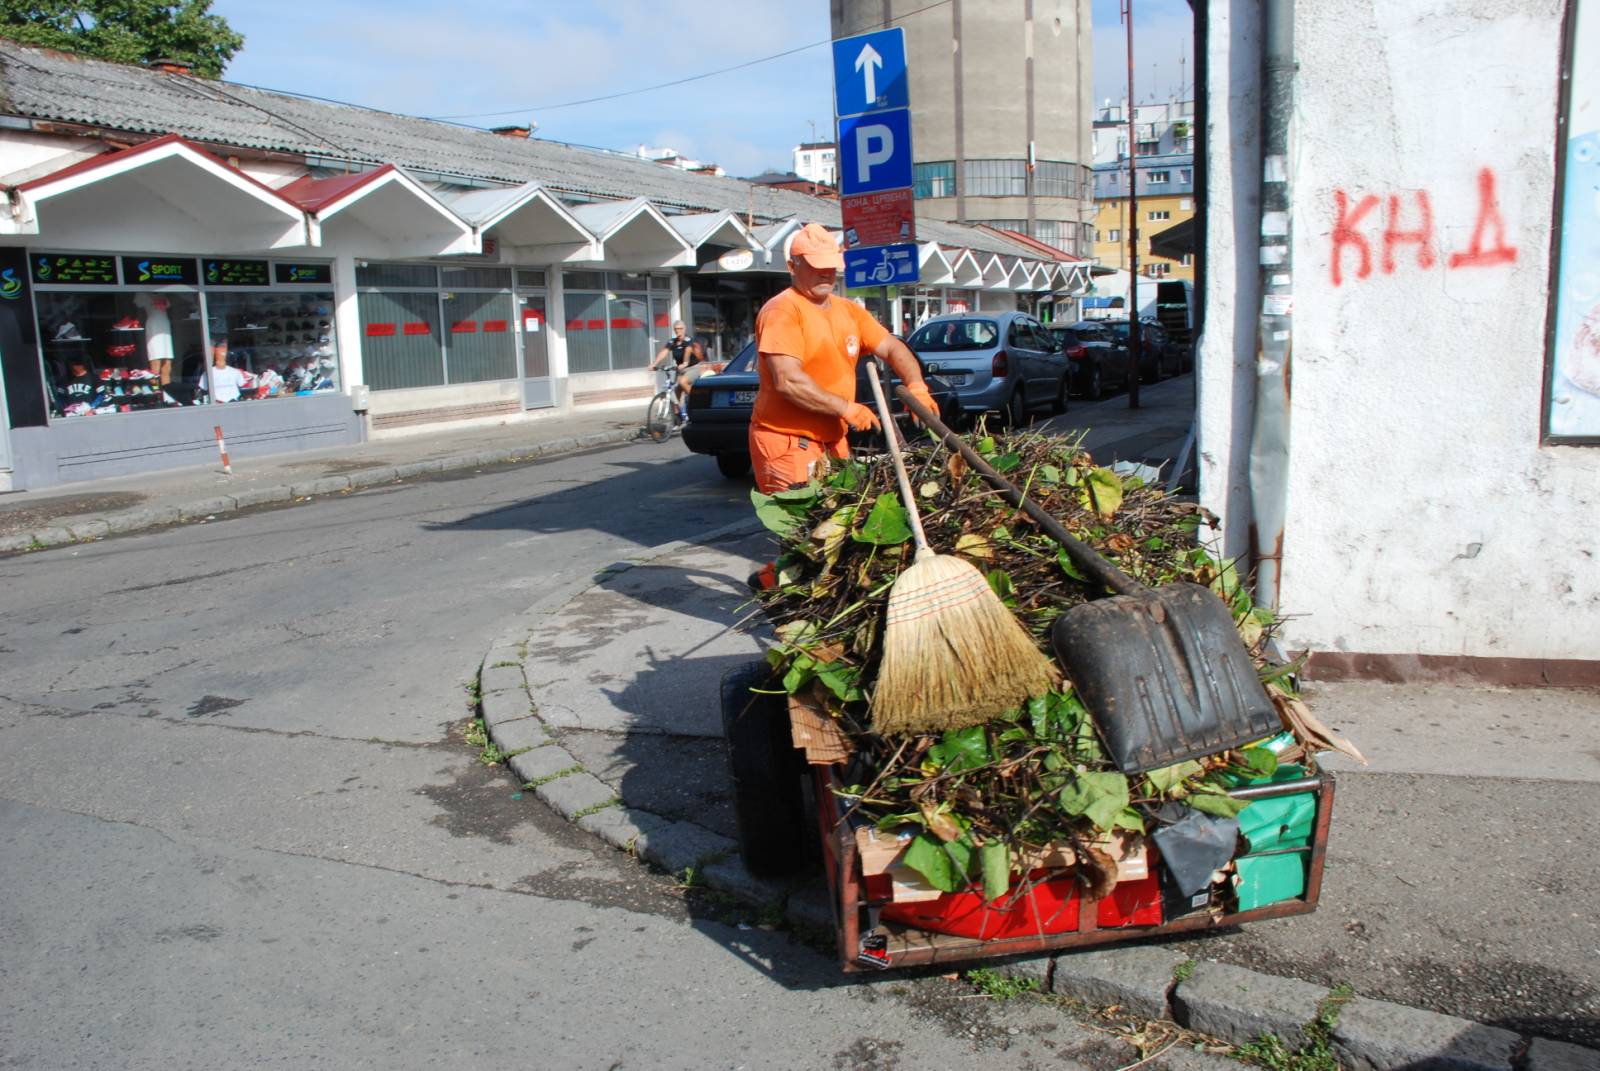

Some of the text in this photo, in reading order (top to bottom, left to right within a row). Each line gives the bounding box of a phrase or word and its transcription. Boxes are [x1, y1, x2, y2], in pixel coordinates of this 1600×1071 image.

[855, 124, 893, 183] P
[845, 195, 868, 209] ЗОНА
[151, 264, 183, 275] SPORT
